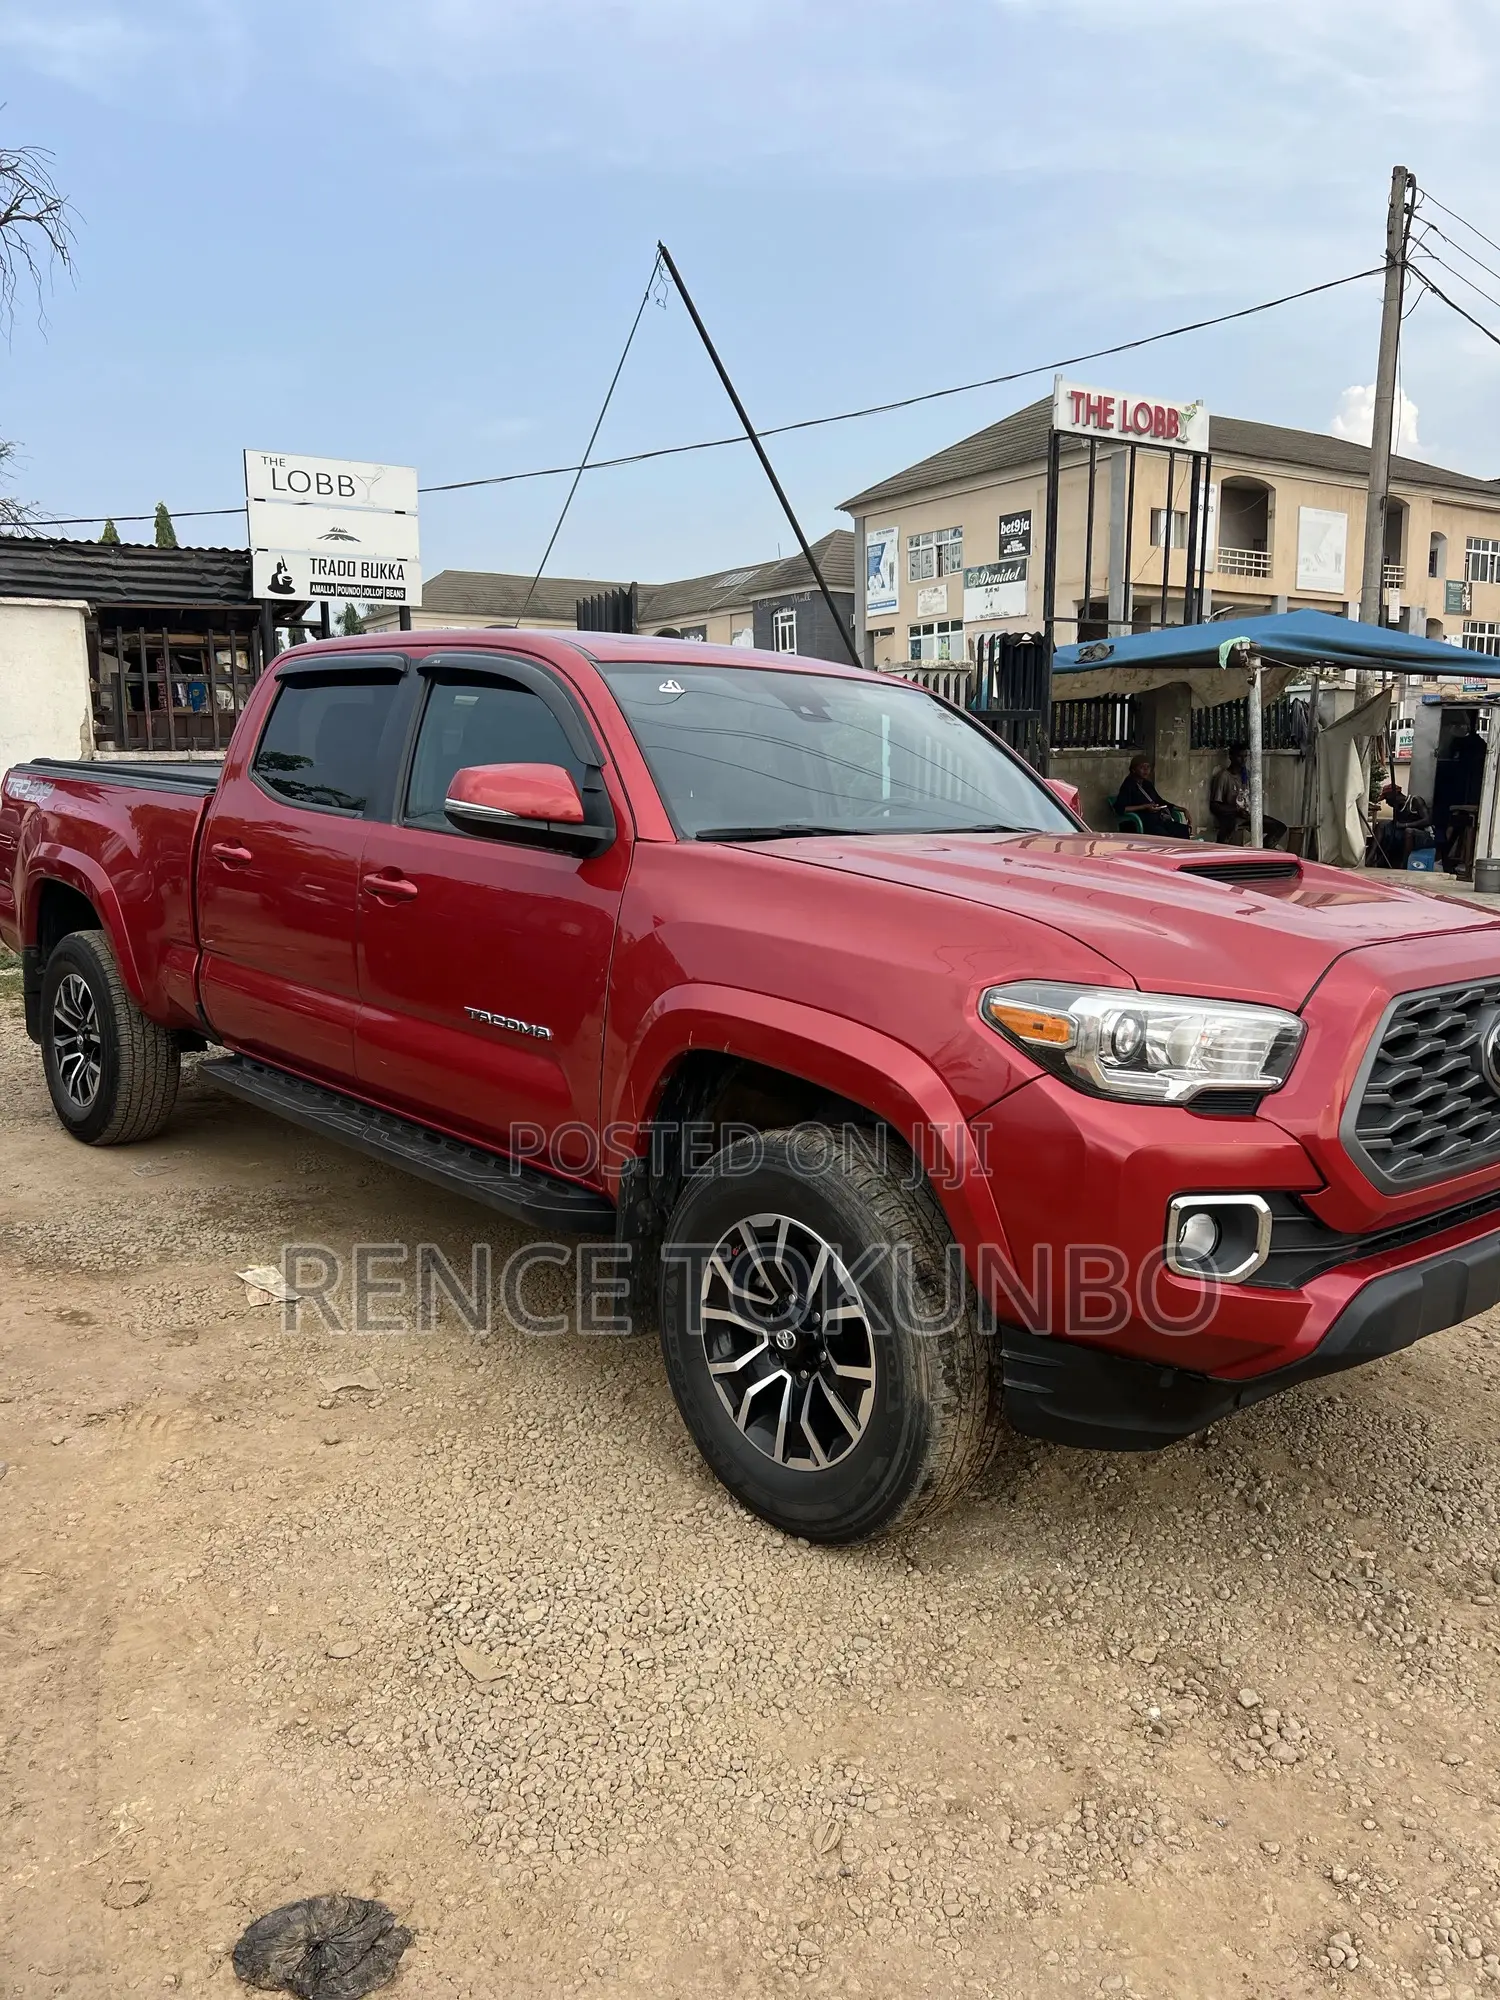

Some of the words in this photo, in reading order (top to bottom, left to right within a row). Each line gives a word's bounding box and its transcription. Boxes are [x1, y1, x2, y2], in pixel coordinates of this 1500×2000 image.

[1066, 390, 1115, 430] THE
[261, 456, 286, 467] THE
[1000, 518, 1030, 535] bet9ja
[361, 561, 405, 581] BUKKA
[311, 584, 335, 595] AMALLA
[337, 585, 361, 597] POUNDO
[362, 586, 383, 598] JOLLOF
[385, 588, 405, 599] BEANS
[463, 1006, 555, 1041] TACOMA
